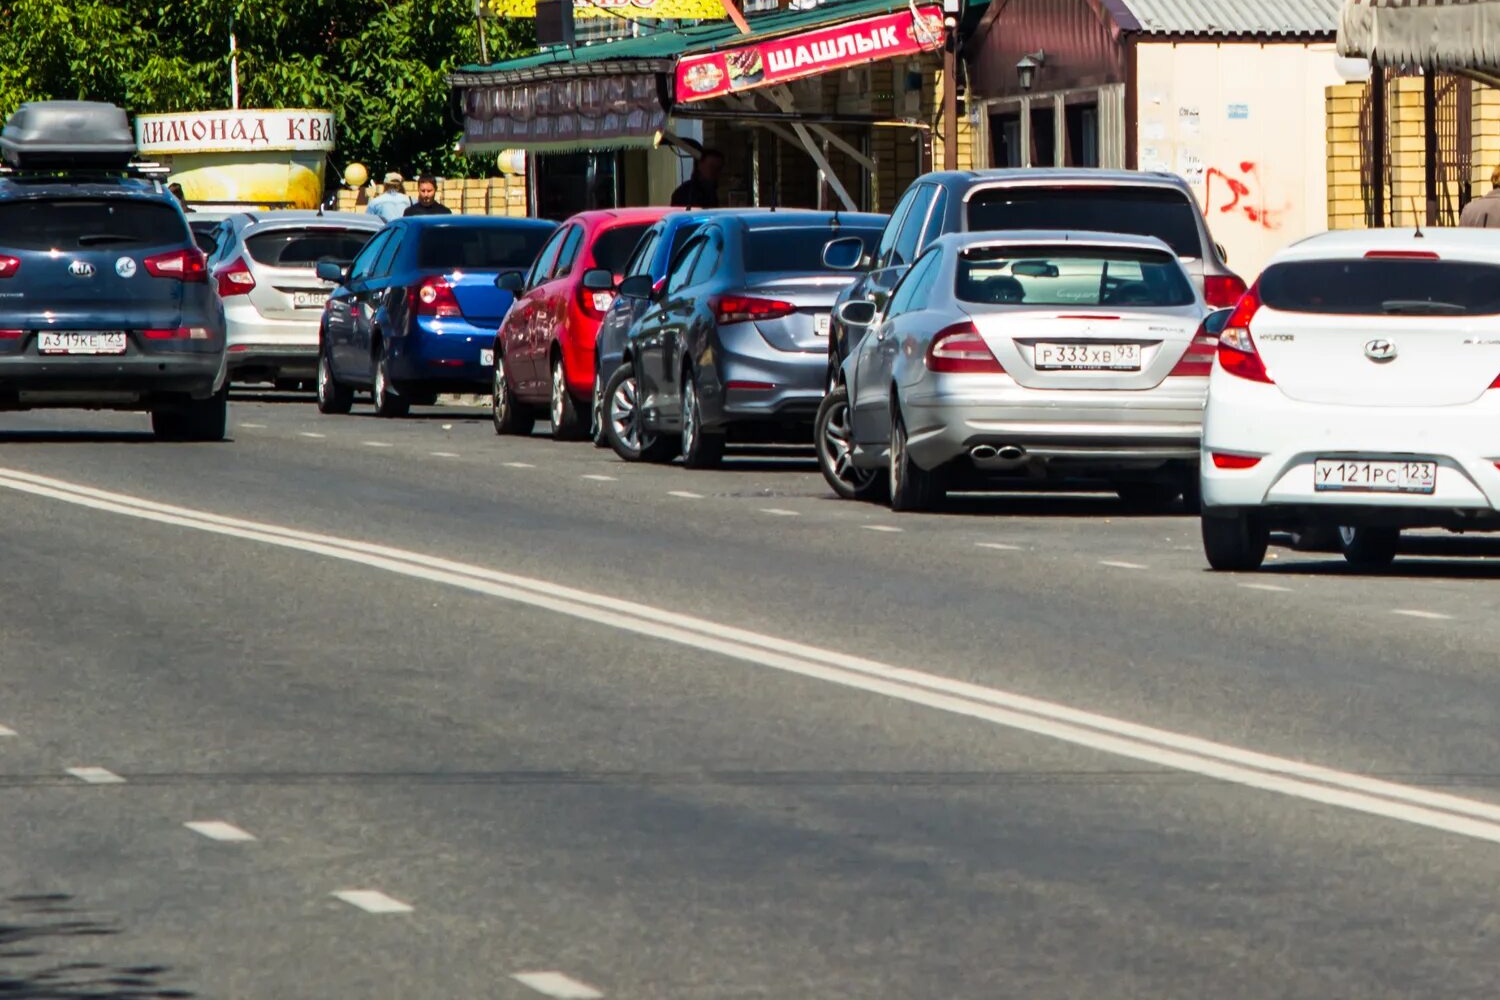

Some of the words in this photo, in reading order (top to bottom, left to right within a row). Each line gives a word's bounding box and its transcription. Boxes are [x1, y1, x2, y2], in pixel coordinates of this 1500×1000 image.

[768, 25, 899, 73] ШАШЛЫК
[143, 118, 269, 144] ЛИМОНАД
[287, 118, 336, 141] КВА
[71, 263, 94, 275] KIA
[44, 332, 98, 347] А319КЕ
[101, 331, 122, 343] 123
[1116, 346, 1135, 360] 93
[1402, 463, 1431, 481] 123
